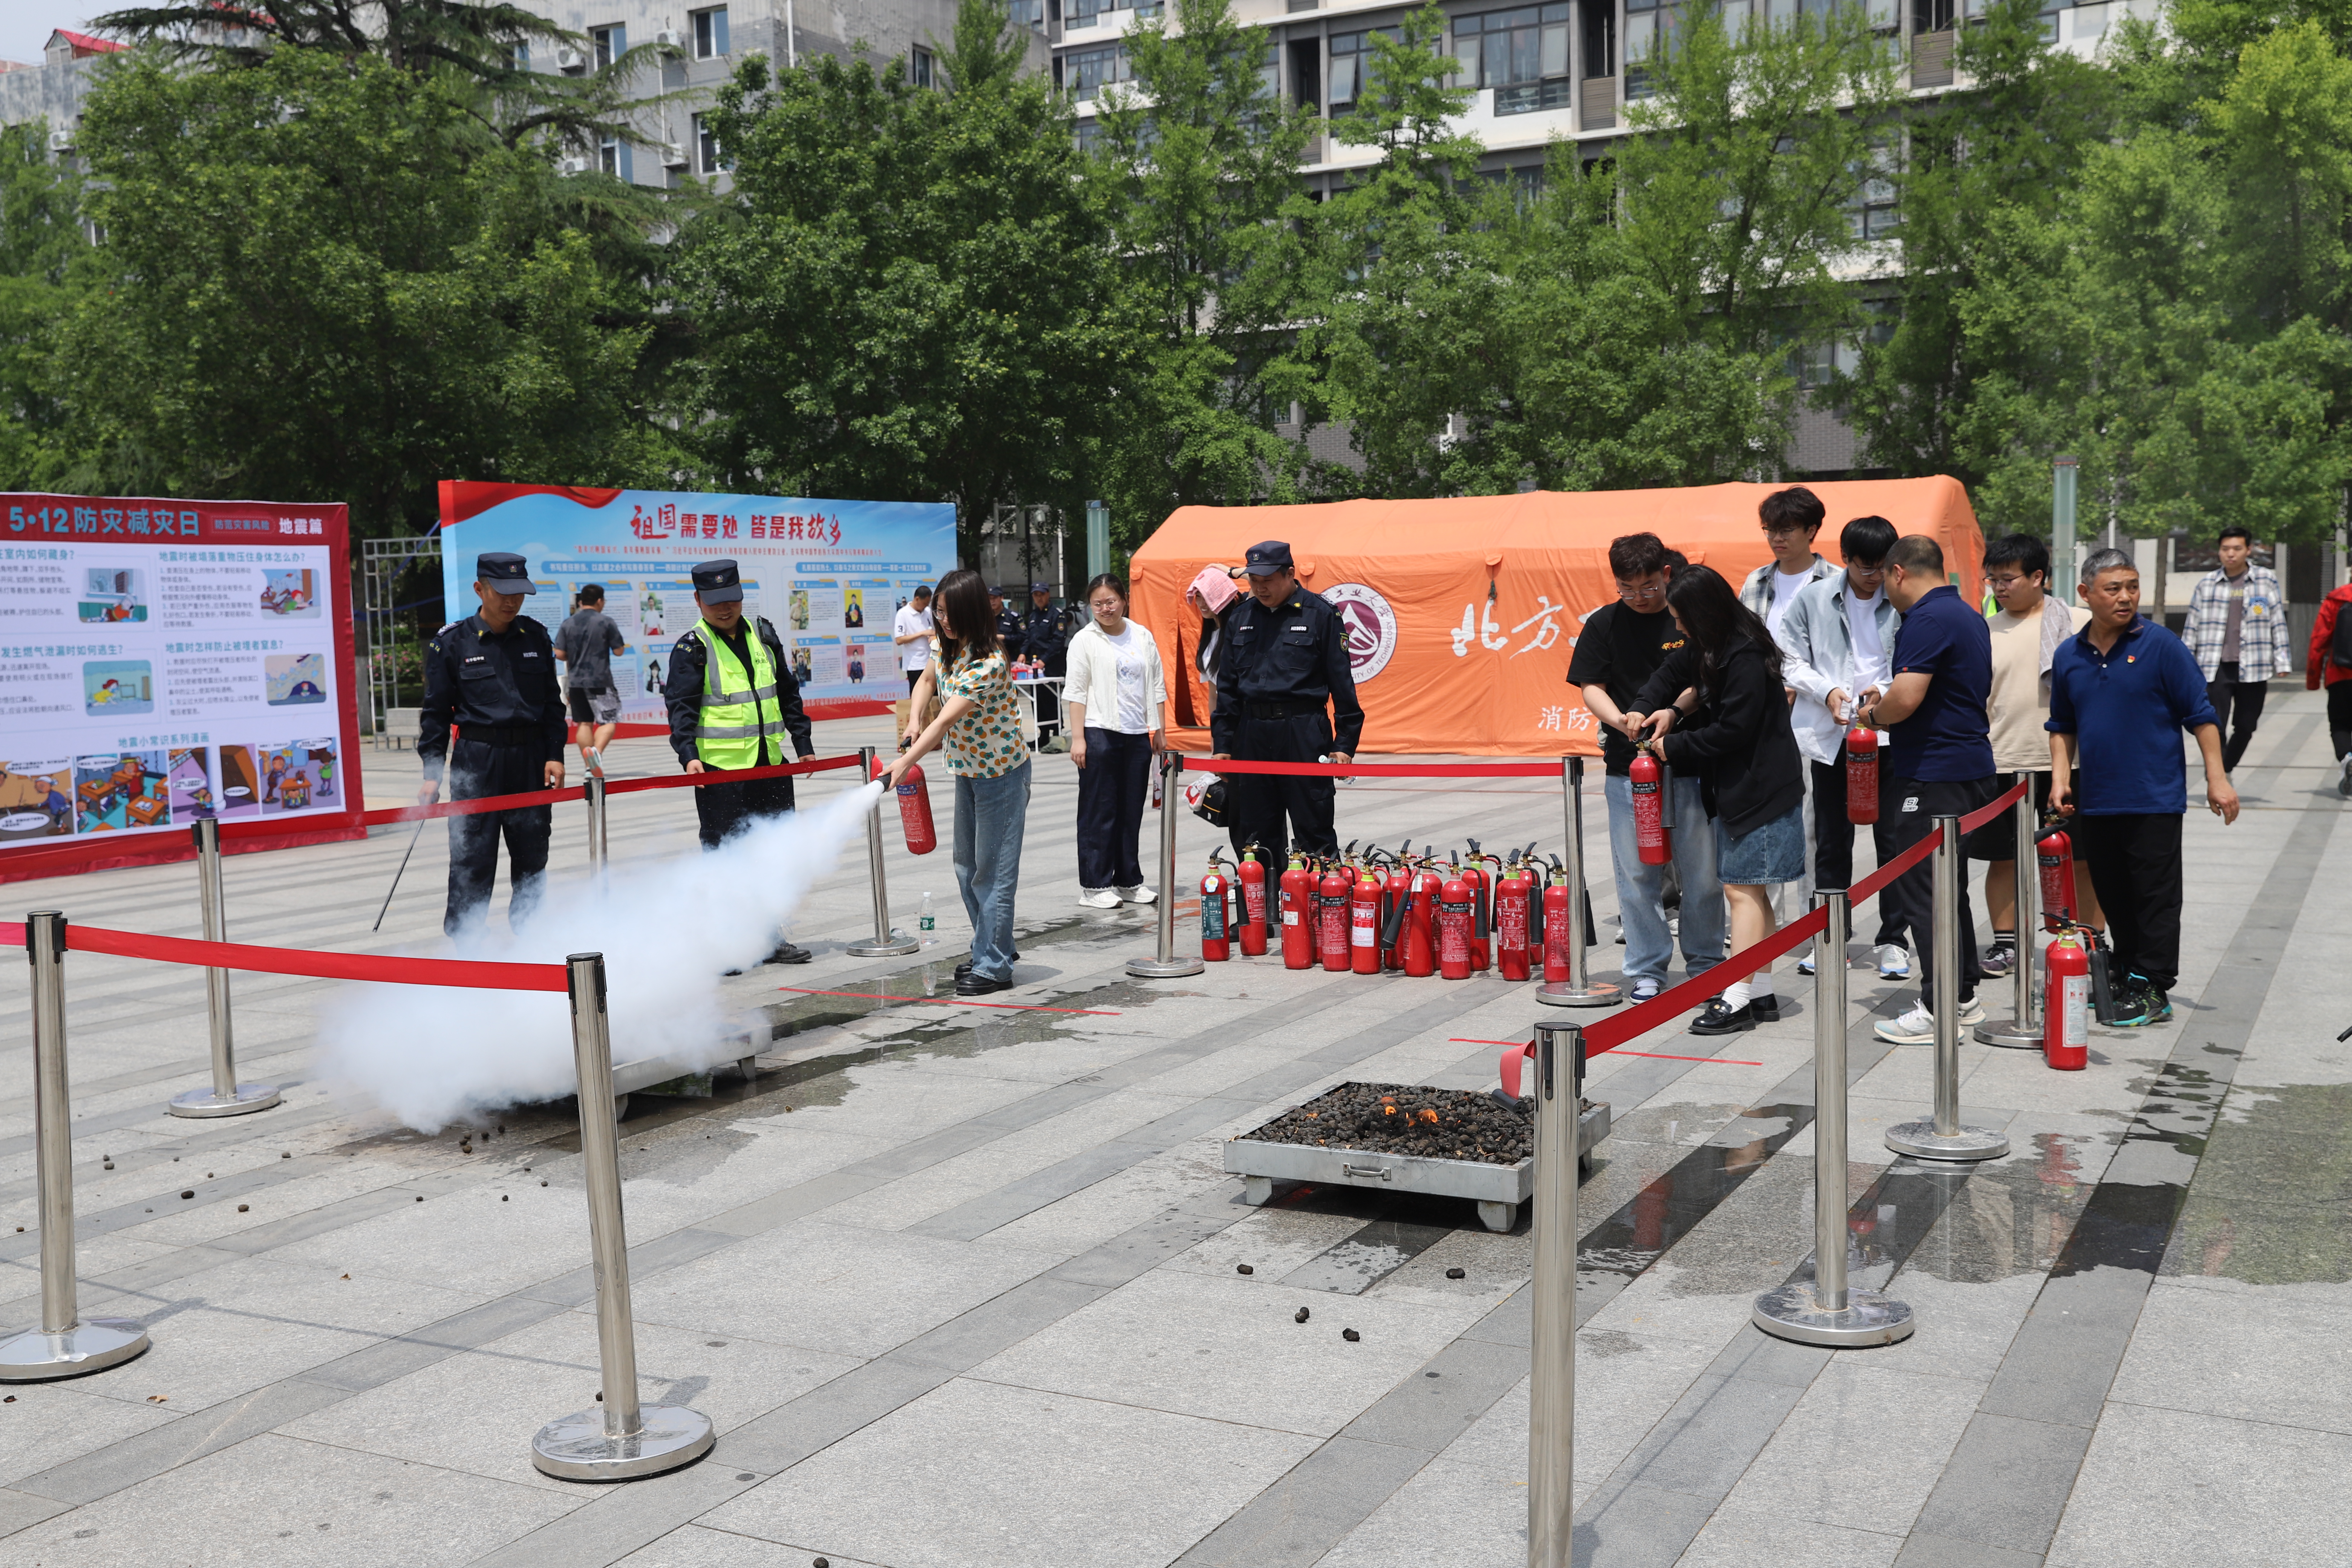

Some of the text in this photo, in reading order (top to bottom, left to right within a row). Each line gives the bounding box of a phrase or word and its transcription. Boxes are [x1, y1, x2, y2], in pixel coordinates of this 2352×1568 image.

[279, 517, 323, 535] 地震篇
[630, 504, 842, 547] 祖国需要处 皆是我故乡
[1450, 596, 1604, 660] 北方
[1375, 621, 1392, 666] TECHNOLOGY
[1366, 665, 1375, 674] OF
[1537, 705, 1599, 732] 消防
[118, 732, 210, 748] 地震小常识系列漫画
